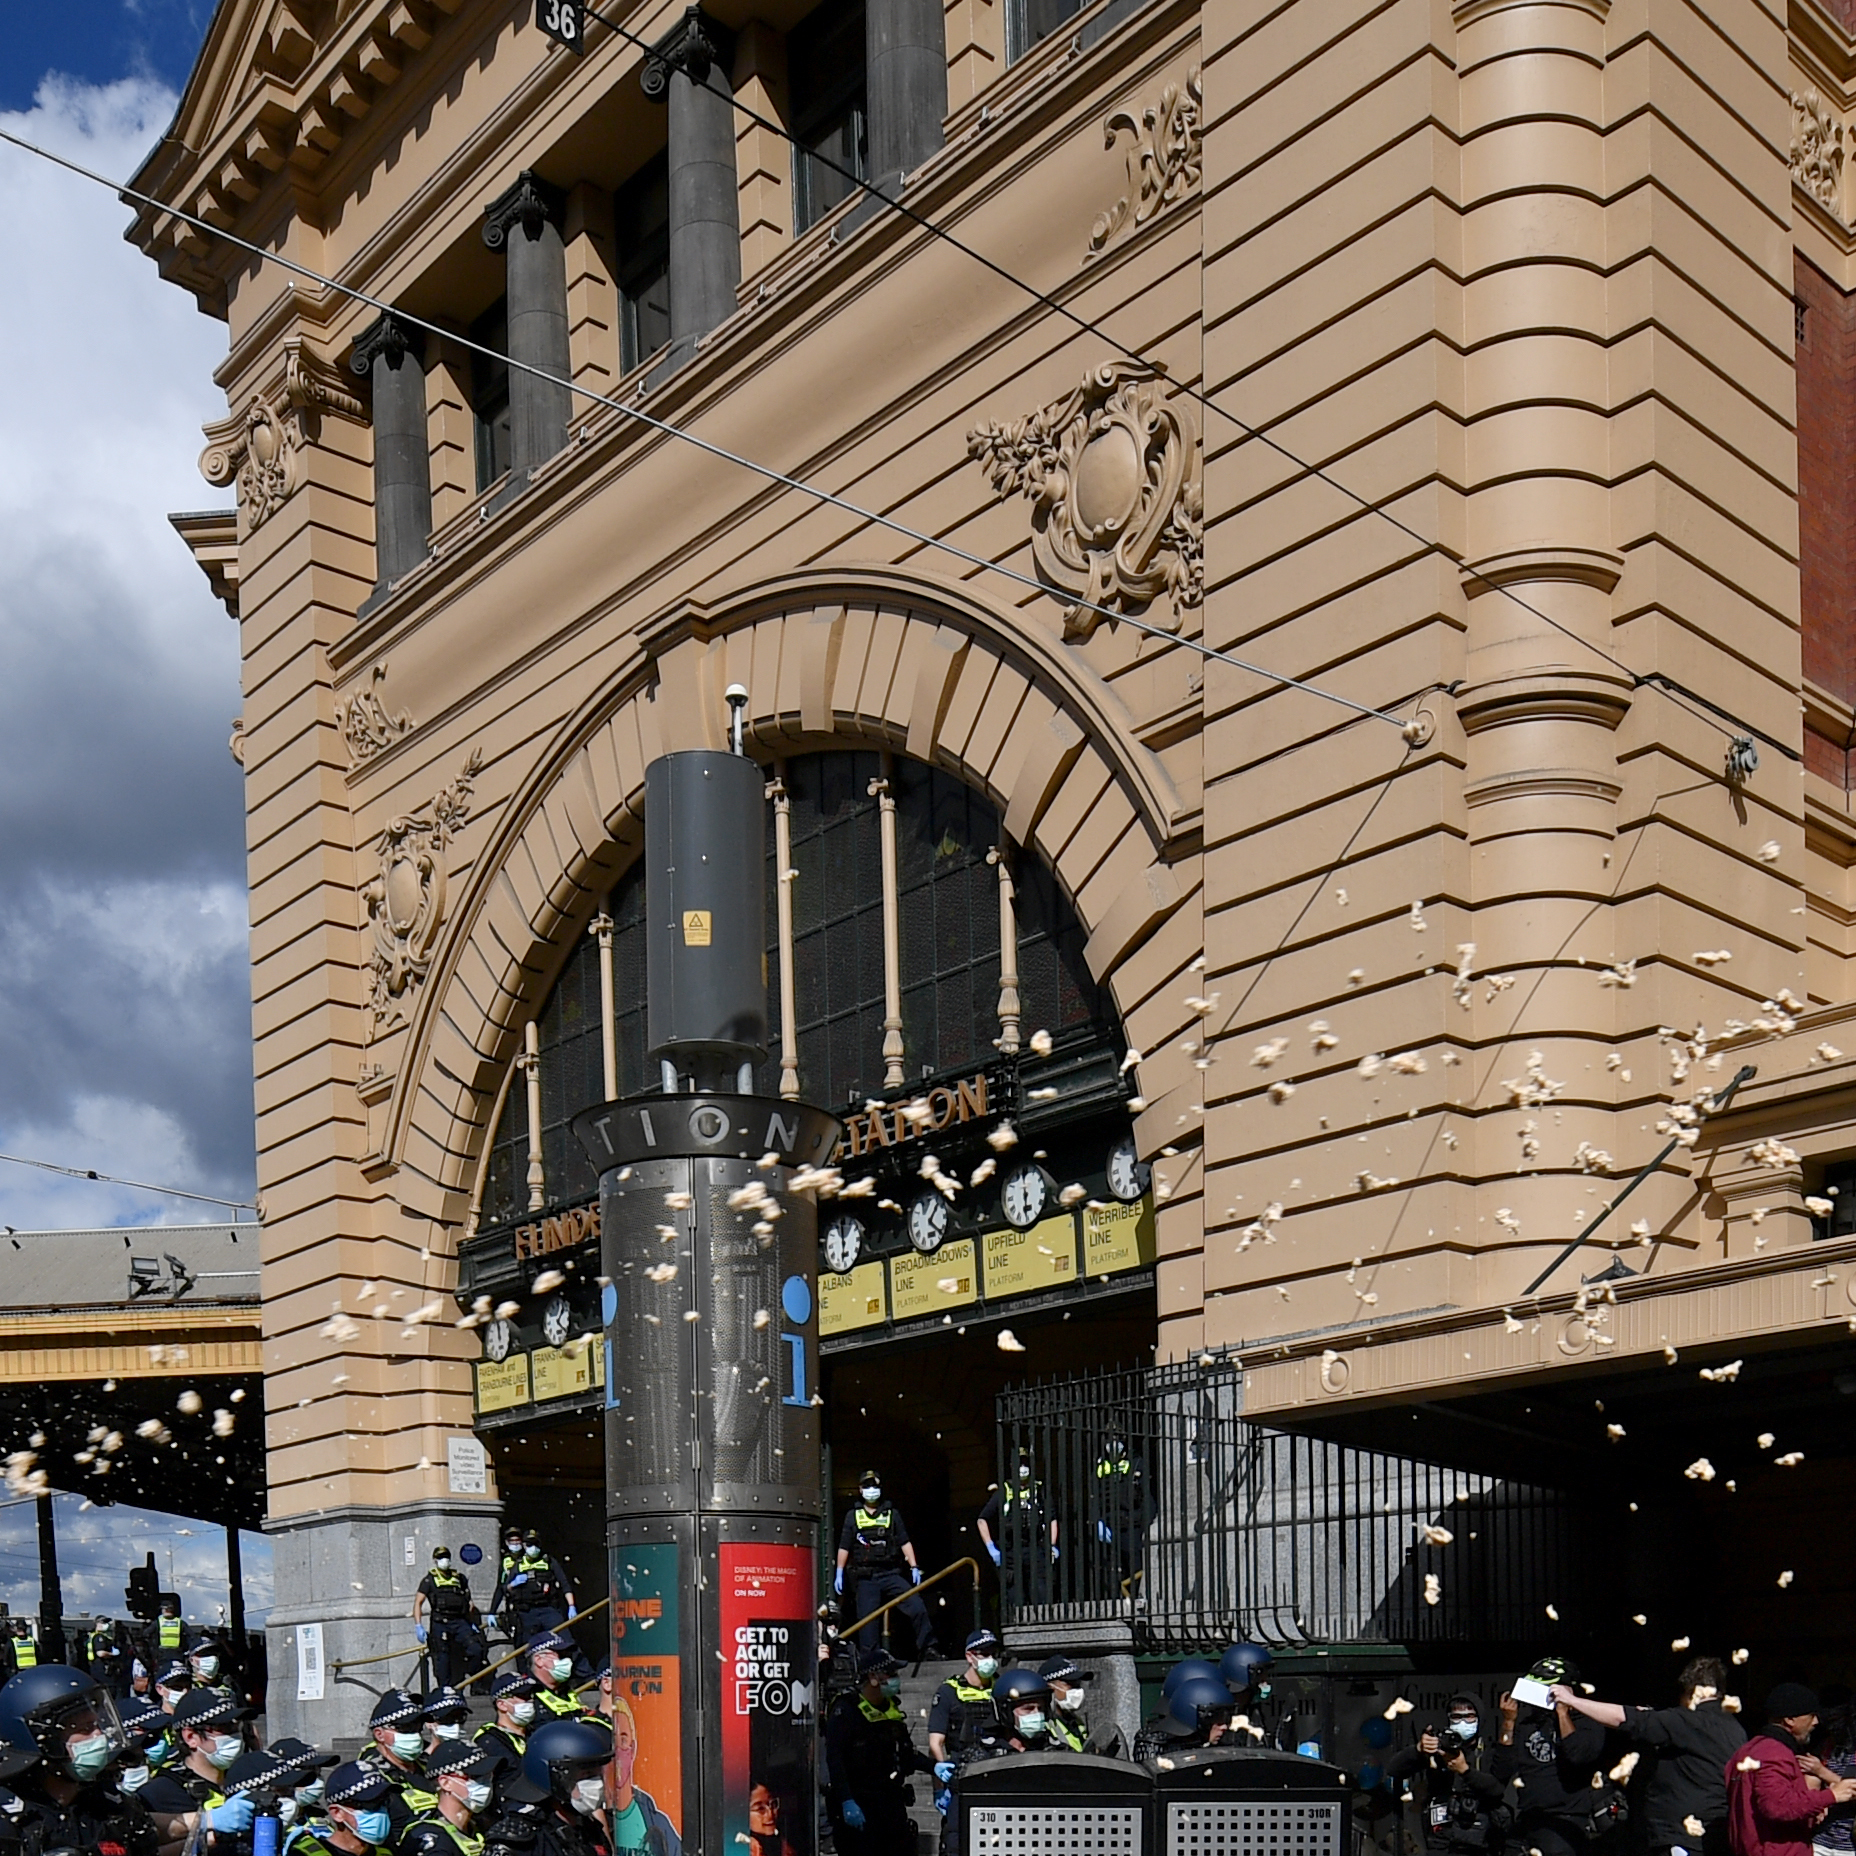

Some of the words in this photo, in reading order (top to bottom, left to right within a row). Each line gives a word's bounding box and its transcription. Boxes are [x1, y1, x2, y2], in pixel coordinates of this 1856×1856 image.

[1089, 1202, 1141, 1227] WERRIBEE
[987, 1232, 1026, 1251] UPFIELD
[1089, 1233, 1111, 1247] LINE
[894, 1244, 970, 1276] BROADMEADOWS
[988, 1254, 1009, 1270] LINE
[1090, 1248, 1129, 1265] PLATFORM
[822, 1274, 853, 1291] ALBANS
[895, 1277, 915, 1292] LINE
[988, 1272, 1024, 1288] PLATFORM
[896, 1293, 929, 1308] PLATFORM
[734, 1589, 746, 1597] ON
[748, 1589, 766, 1597] NOW
[734, 1626, 767, 1644] GET
[769, 1627, 789, 1644] TO
[734, 1644, 777, 1660] ACMI
[735, 1662, 760, 1679] OR
[763, 1662, 791, 1679] GET
[979, 1812, 996, 1823] 310
[1308, 1808, 1332, 1819] 310R
